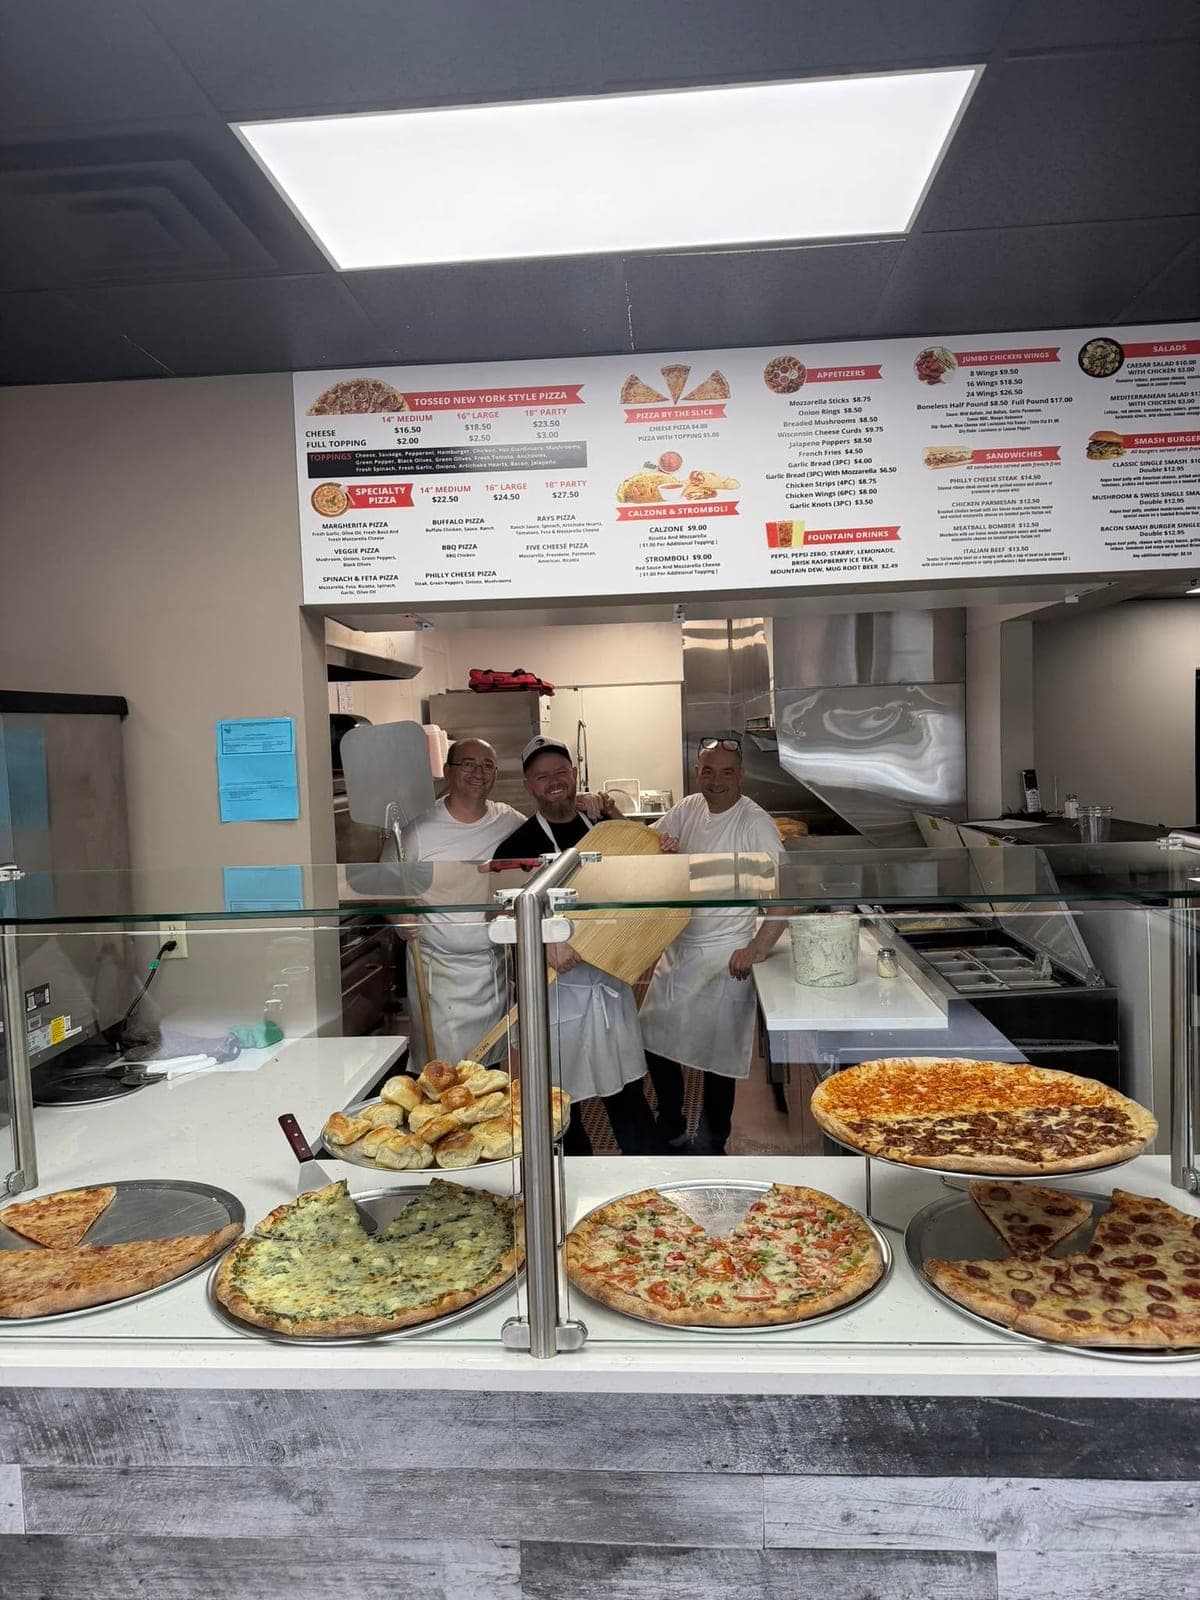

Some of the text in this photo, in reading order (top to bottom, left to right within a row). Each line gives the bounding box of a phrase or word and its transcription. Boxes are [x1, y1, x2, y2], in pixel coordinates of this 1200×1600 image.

[1153, 344, 1186, 352] SALADS
[962, 355, 988, 363] JUMBO
[817, 370, 865, 378] APPETIZERS
[454, 396, 475, 404] NEW
[509, 393, 536, 401] STYLE
[540, 392, 567, 400] PIZZA
[976, 390, 998, 398] Wings
[472, 411, 499, 419] LARGE
[540, 408, 567, 416] PARTY
[636, 411, 659, 419] PIZZA
[397, 414, 432, 422] MEDIUM
[395, 426, 421, 434] $16.50
[533, 420, 559, 428] $23.50
[310, 453, 352, 461] TOPPINGS
[986, 451, 1042, 459] SANDWICHES
[501, 483, 527, 491] LARGE
[560, 480, 587, 488] PARTY
[356, 487, 406, 496] SPECIALTY
[369, 496, 396, 504] PIZZA
[494, 493, 520, 501] $24.50
[552, 491, 579, 499] $27.50
[628, 509, 667, 517] CALZONE
[678, 505, 728, 514] STROMBOLI
[808, 532, 853, 540] FOUNTAIN
[645, 555, 688, 563] STROMBOLI
